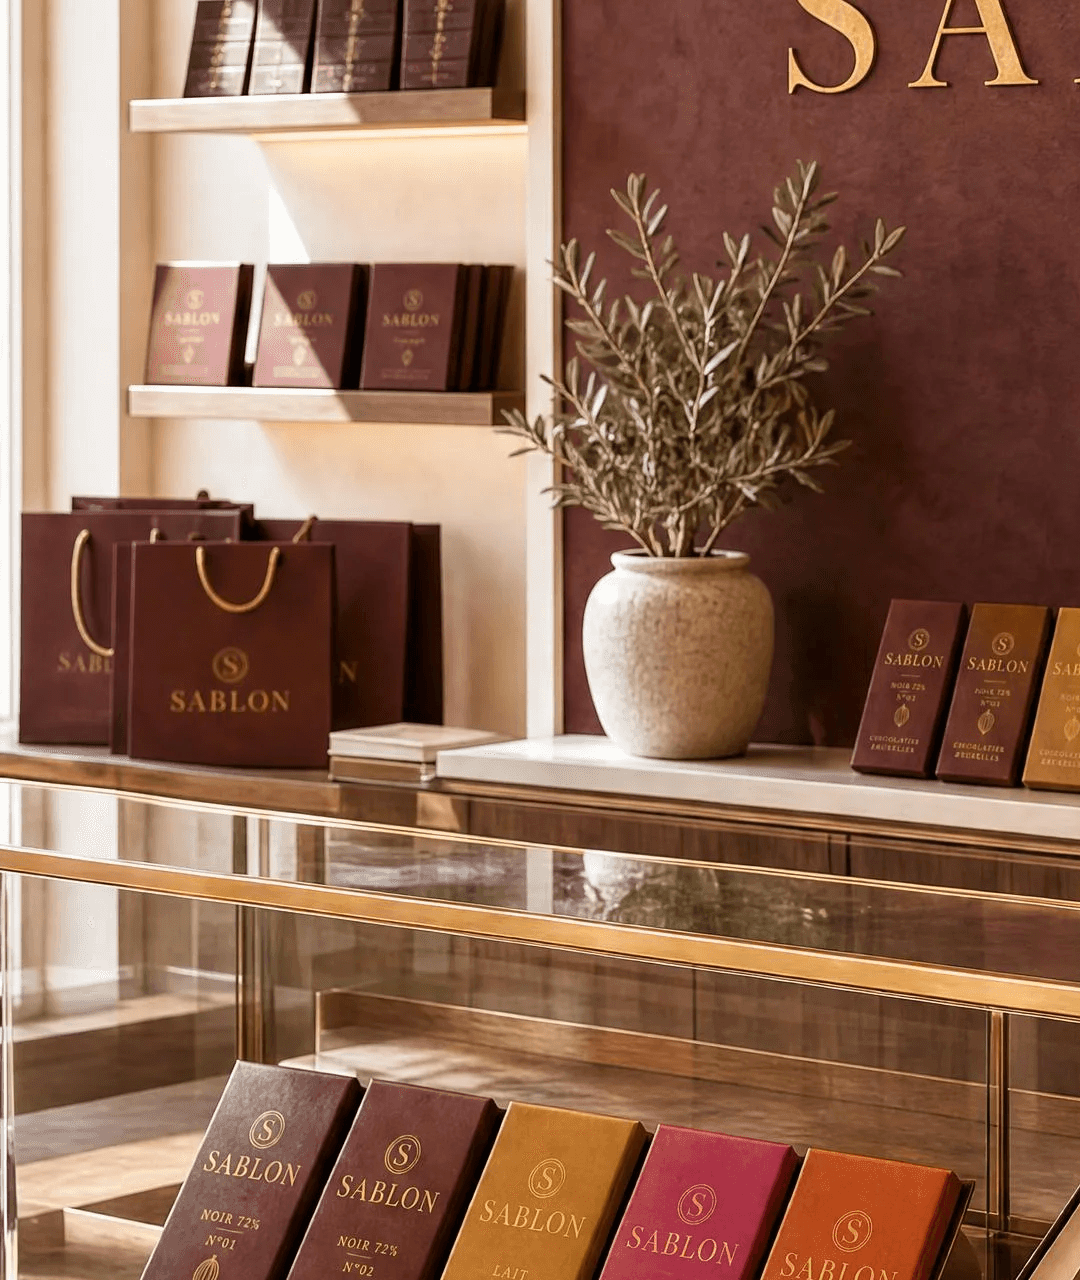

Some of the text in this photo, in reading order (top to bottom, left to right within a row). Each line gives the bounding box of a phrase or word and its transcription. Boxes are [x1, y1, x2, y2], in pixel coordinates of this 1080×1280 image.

[383, 314, 439, 326] SABLON
[915, 635, 923, 644] S
[998, 639, 1006, 650] S
[885, 653, 943, 668] SABLON
[967, 657, 1029, 673] SABLON
[171, 690, 290, 712] SABLON
[257, 1120, 275, 1141] S
[393, 1144, 411, 1165] S
[204, 1150, 301, 1186] SABLON
[536, 1167, 556, 1190] S
[337, 1175, 440, 1213] SABLON
[687, 1192, 706, 1216] S
[200, 1209, 260, 1230] NOIR 72%
[480, 1199, 586, 1239] SABLON
[842, 1218, 862, 1243] S
[205, 1235, 236, 1251] N°01
[337, 1235, 398, 1257] NOIR 72%
[626, 1226, 739, 1266] SABLON
[343, 1262, 374, 1277] N°02
[493, 1265, 529, 1280] LAIT
